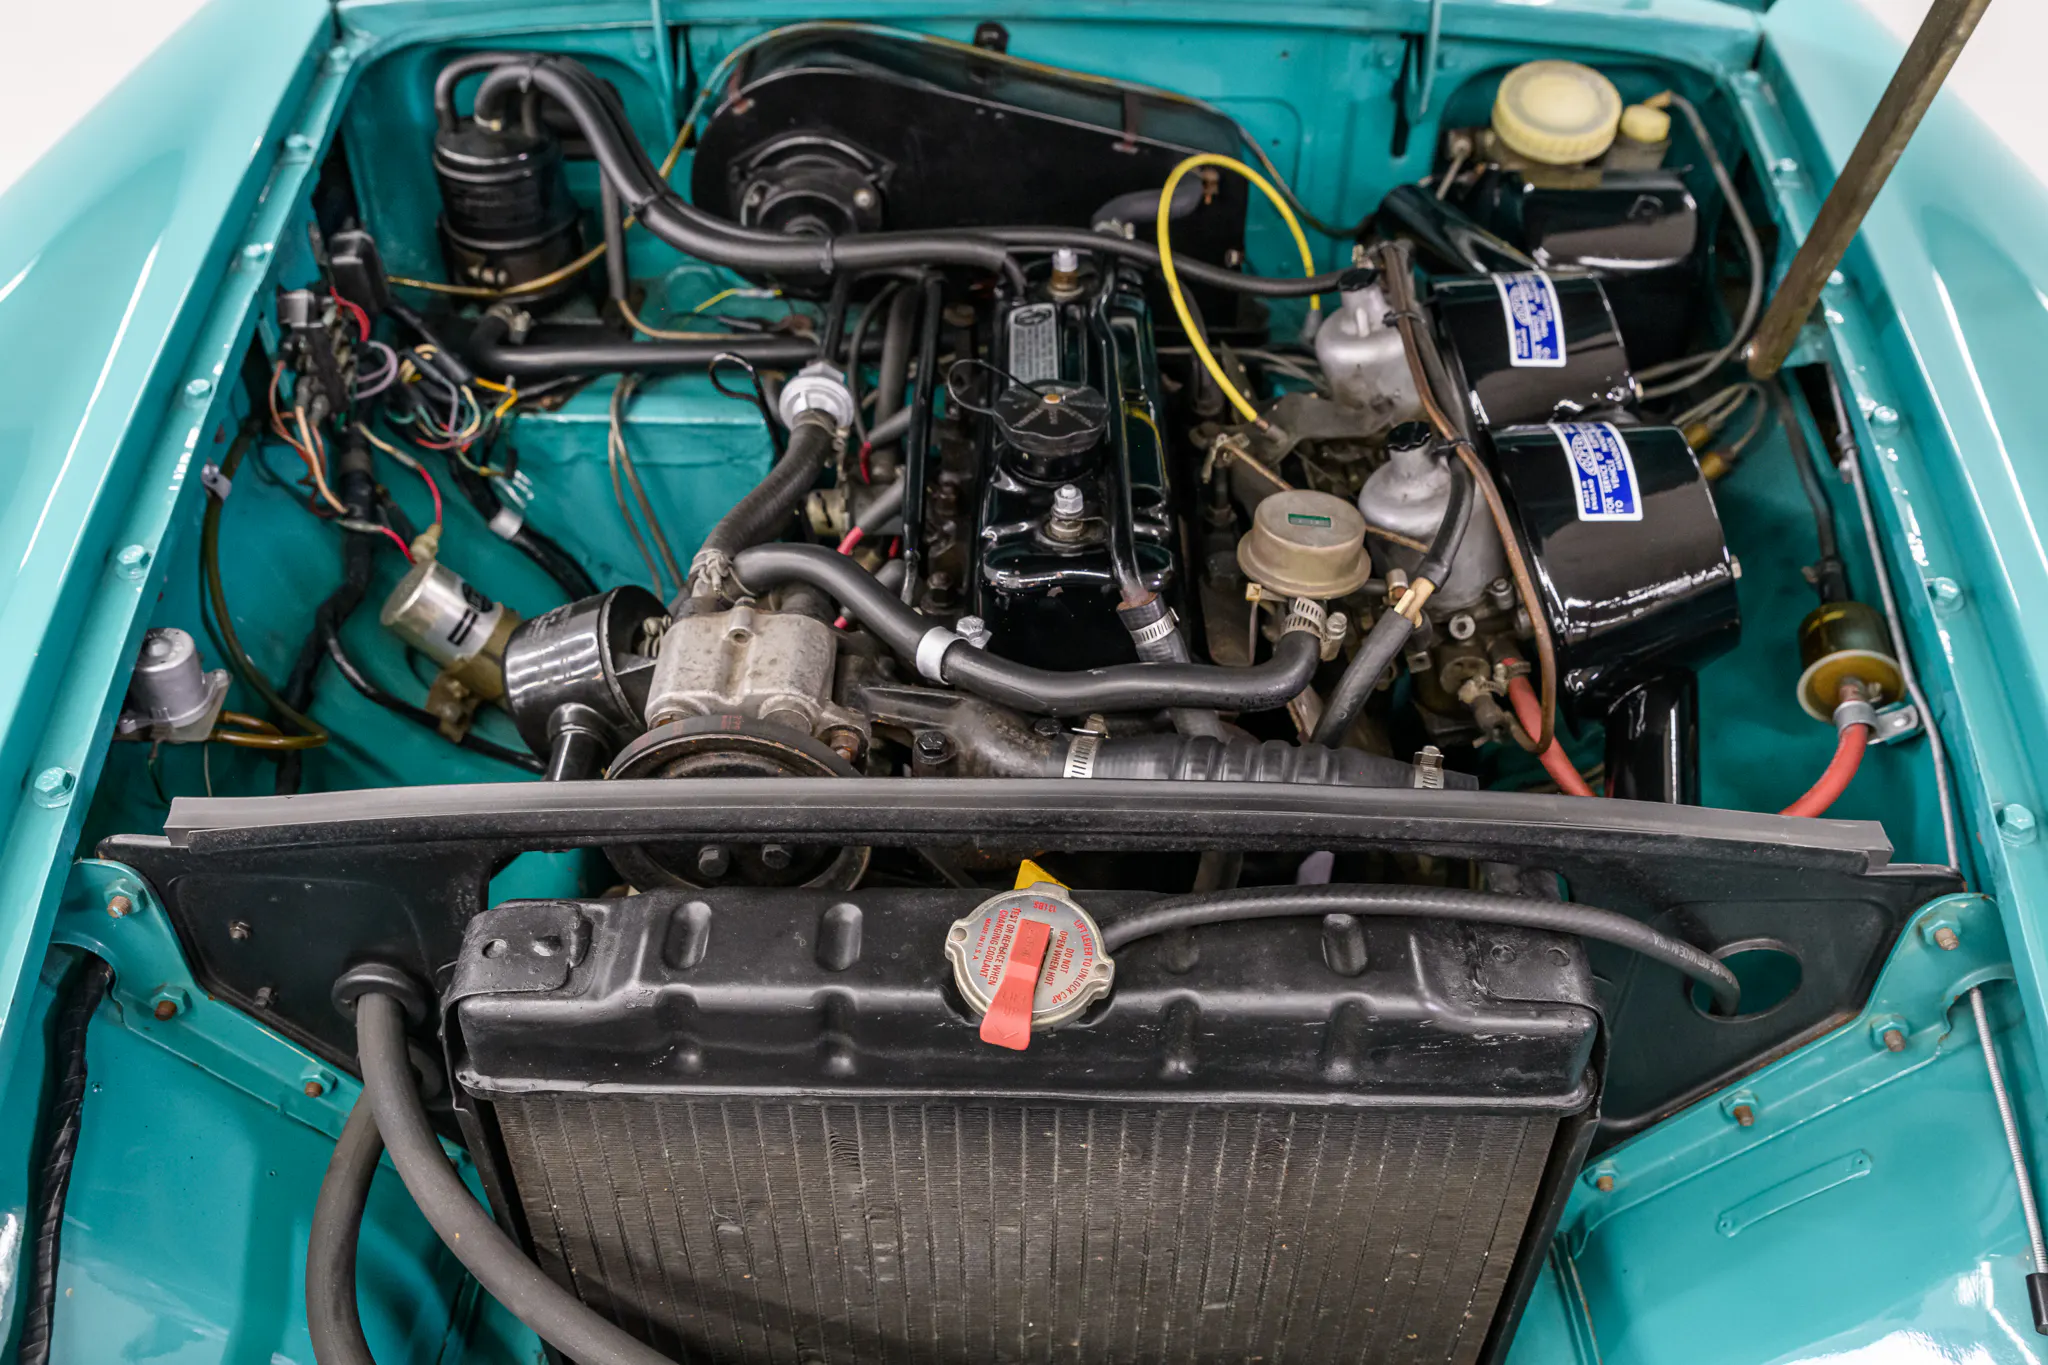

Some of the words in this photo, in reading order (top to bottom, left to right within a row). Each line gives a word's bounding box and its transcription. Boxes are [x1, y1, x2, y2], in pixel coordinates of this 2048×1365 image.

[1615, 500, 1624, 513] TO
[1008, 907, 1021, 924] TEST
[981, 917, 992, 935] MADE
[990, 909, 1008, 945] CHANGING
[1005, 924, 1015, 934] OR
[1073, 919, 1088, 933] LIFT
[979, 935, 986, 943] IN
[1055, 930, 1068, 949] OPEN
[1081, 934, 1092, 956] LEVER
[995, 934, 1012, 964] REPLACE
[1064, 947, 1075, 958] DO
[980, 945, 997, 979] COOLANT
[1048, 949, 1061, 970] WHEN
[1060, 958, 1072, 974] NOT
[1082, 958, 1092, 967] TO
[987, 964, 1001, 986] WHEN
[1044, 971, 1055, 986] HOT
[1065, 967, 1090, 995] UNLOCK
[1052, 991, 1067, 1004] CAP
